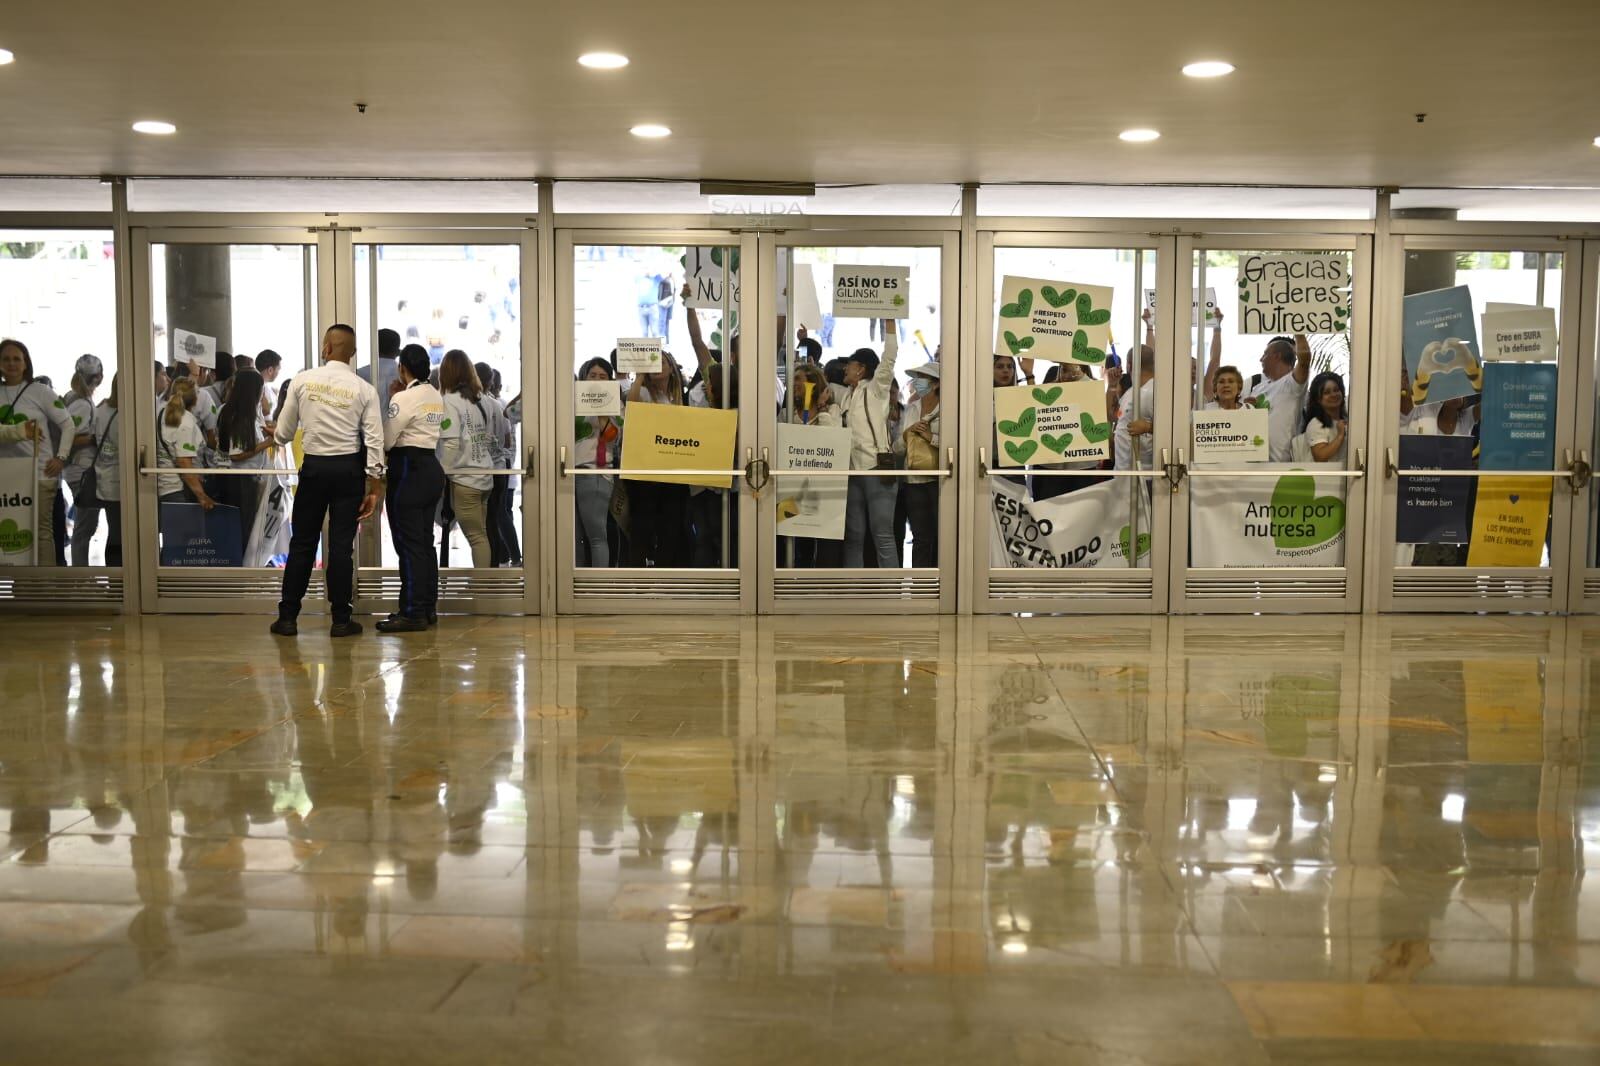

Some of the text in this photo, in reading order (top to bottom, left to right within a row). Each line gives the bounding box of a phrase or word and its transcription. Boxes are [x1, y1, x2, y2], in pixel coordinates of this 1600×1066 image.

[711, 199, 804, 215] SALIDA
[1245, 256, 1341, 282] Gracias
[838, 276, 898, 289] ASÍ NO ES
[836, 288, 878, 298] GILINSKI
[1257, 282, 1341, 304] Líderes
[1033, 309, 1067, 318] #RESPETO
[1031, 326, 1073, 337] CONSTRUIDO
[1496, 333, 1512, 342] Creo
[1523, 331, 1541, 340] SURA
[1511, 344, 1540, 353] defiendo
[1037, 422, 1079, 432] CONSTRUIDO
[1195, 422, 1231, 430] RESPETO
[655, 434, 700, 447] Respeto
[1195, 434, 1248, 443] CONSTRUIDO
[788, 446, 804, 455] Creo
[816, 447, 835, 457] SURA
[1064, 448, 1104, 458] NUTRESA
[789, 457, 833, 469] y la defiendo
[0, 493, 32, 507] ido
[1245, 501, 1334, 522] Amor por
[1508, 515, 1524, 523] SURA
[1244, 521, 1316, 537] nutresa
